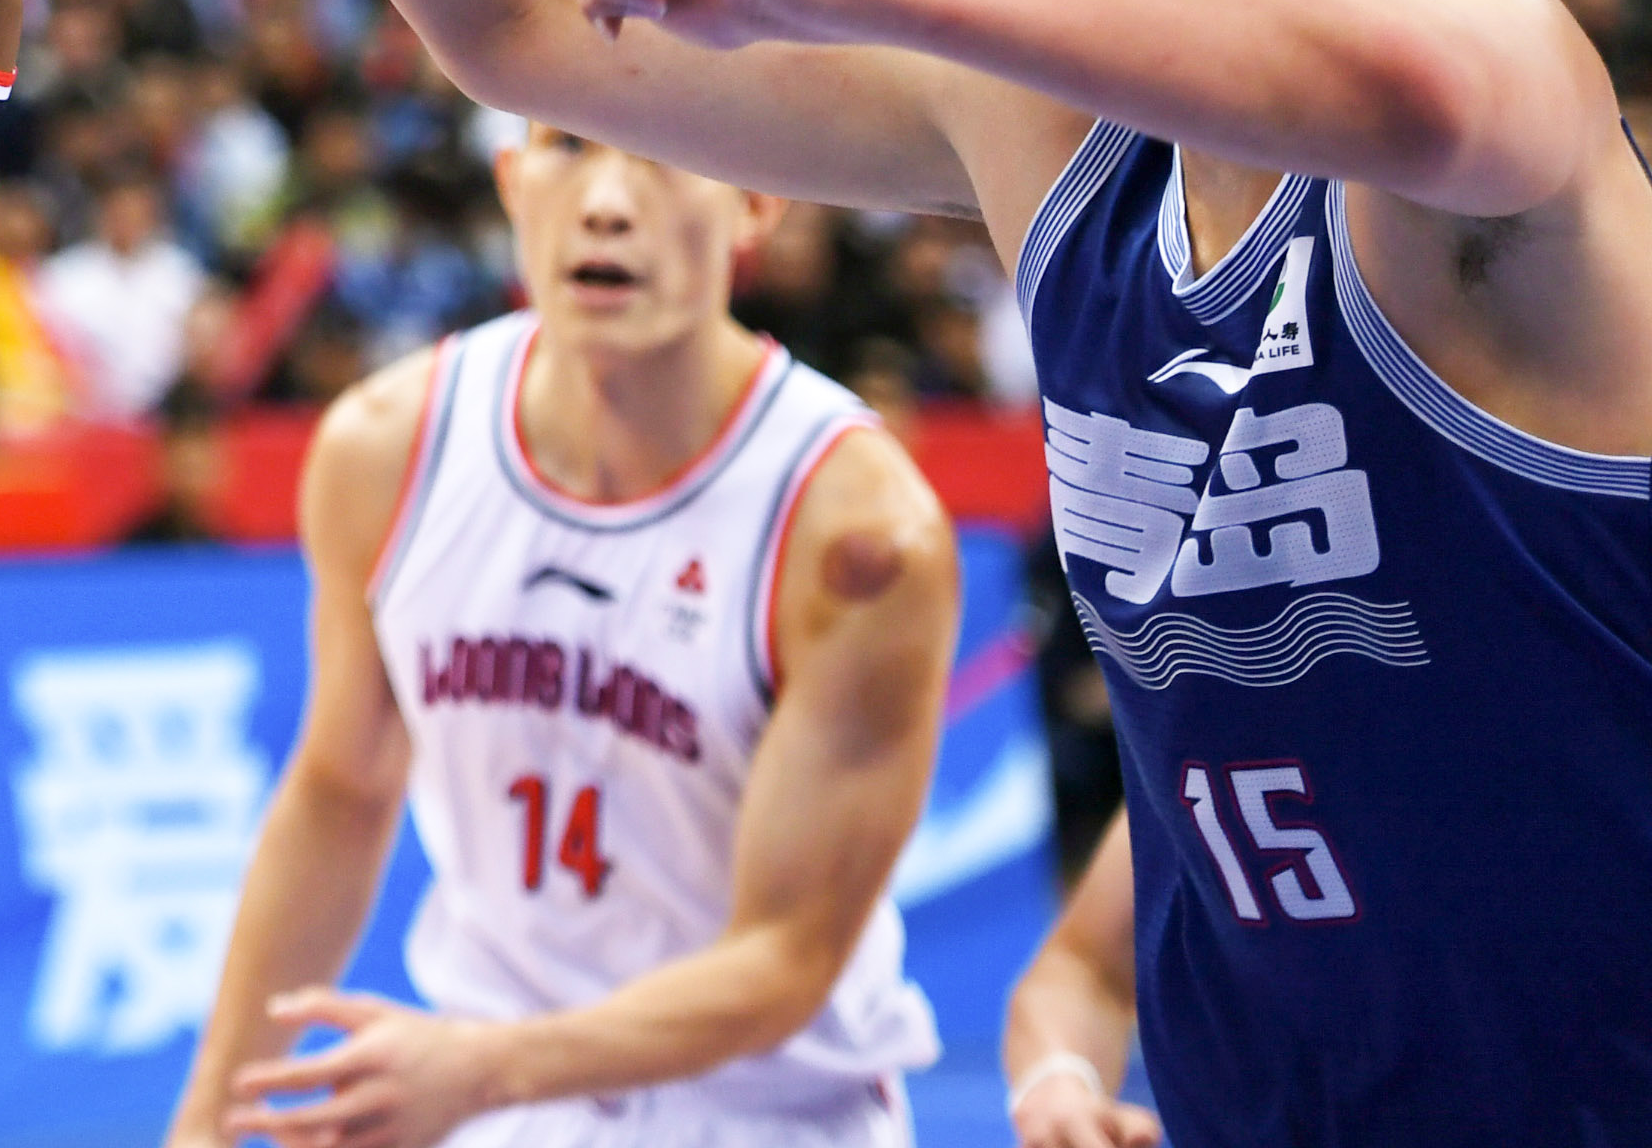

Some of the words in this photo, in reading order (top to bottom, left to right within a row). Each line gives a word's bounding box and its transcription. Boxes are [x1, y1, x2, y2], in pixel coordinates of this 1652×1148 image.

[1268, 344, 1301, 359] LIFE
[1044, 396, 1381, 605] 青岛
[509, 774, 613, 901] 14
[1179, 758, 1360, 925] 15
